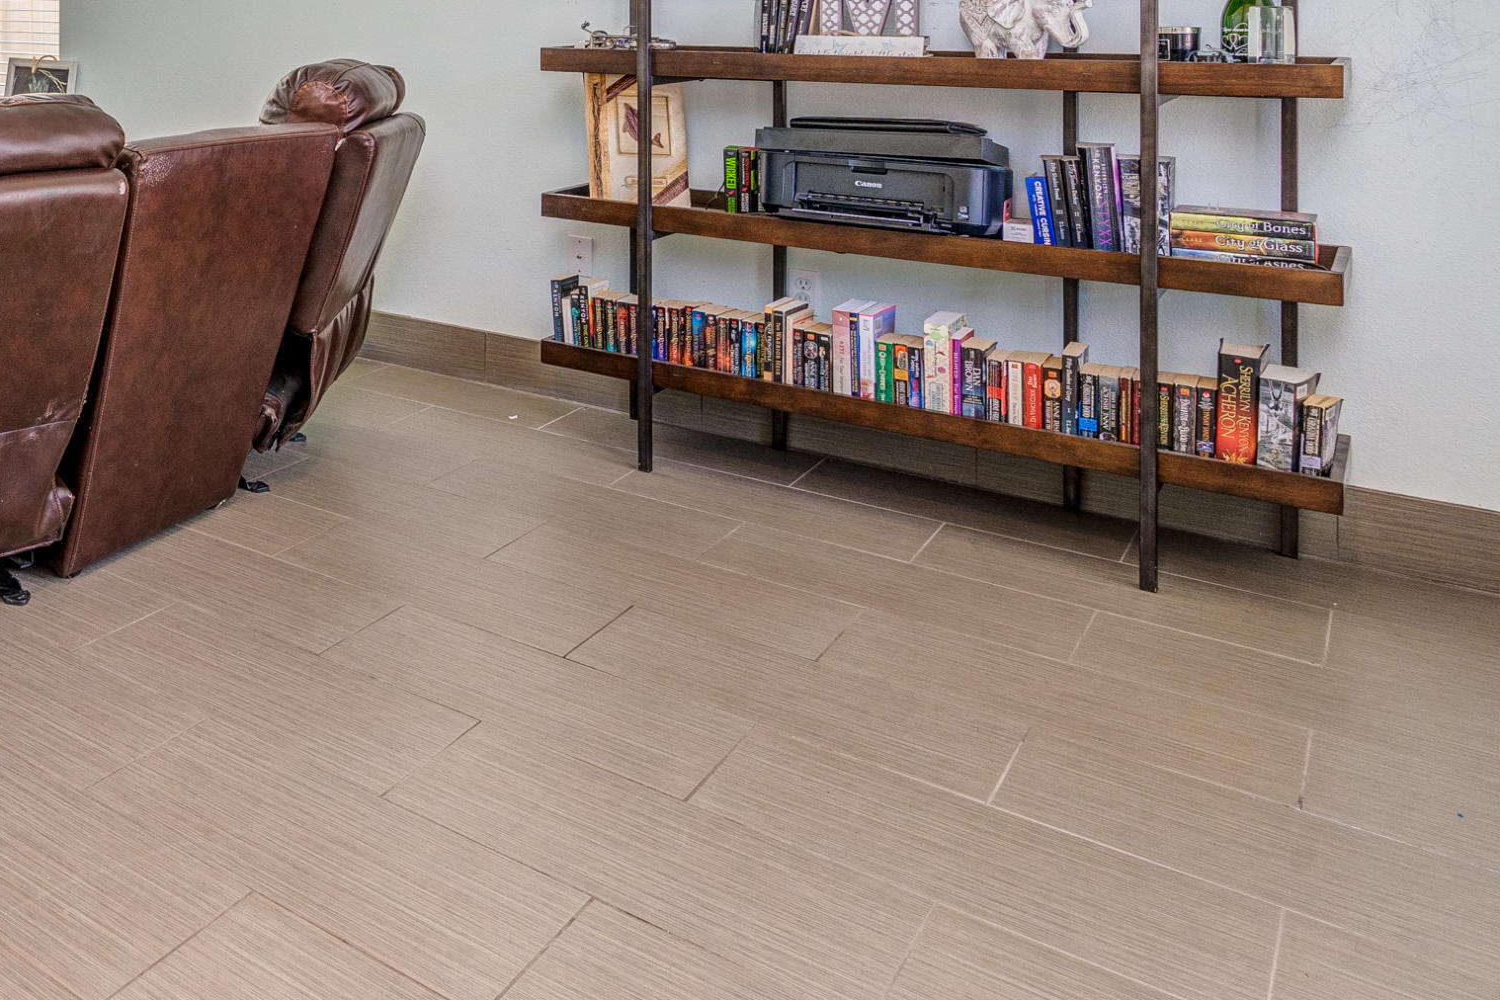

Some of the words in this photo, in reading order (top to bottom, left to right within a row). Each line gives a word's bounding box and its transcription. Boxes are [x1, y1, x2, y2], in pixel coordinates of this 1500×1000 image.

[725, 157, 737, 189] WICKED
[855, 180, 883, 188] Canon
[1092, 158, 1104, 199] KENYON
[1034, 181, 1047, 216] CREATIVE
[1039, 217, 1052, 245] CURSIN
[1097, 201, 1113, 246] STYXX
[1215, 217, 1245, 232] City
[1249, 221, 1259, 231] of
[1263, 221, 1307, 235] Bones
[1214, 235, 1246, 250] City
[1249, 239, 1261, 250] of
[1264, 240, 1304, 253] Glass
[964, 360, 974, 391] BROWN
[973, 367, 982, 387] DAN
[1239, 365, 1254, 412] SHERRILYN
[1053, 400, 1061, 419] ANNE
[1219, 373, 1240, 439] ACHERON
[1235, 414, 1252, 452] KENYON
